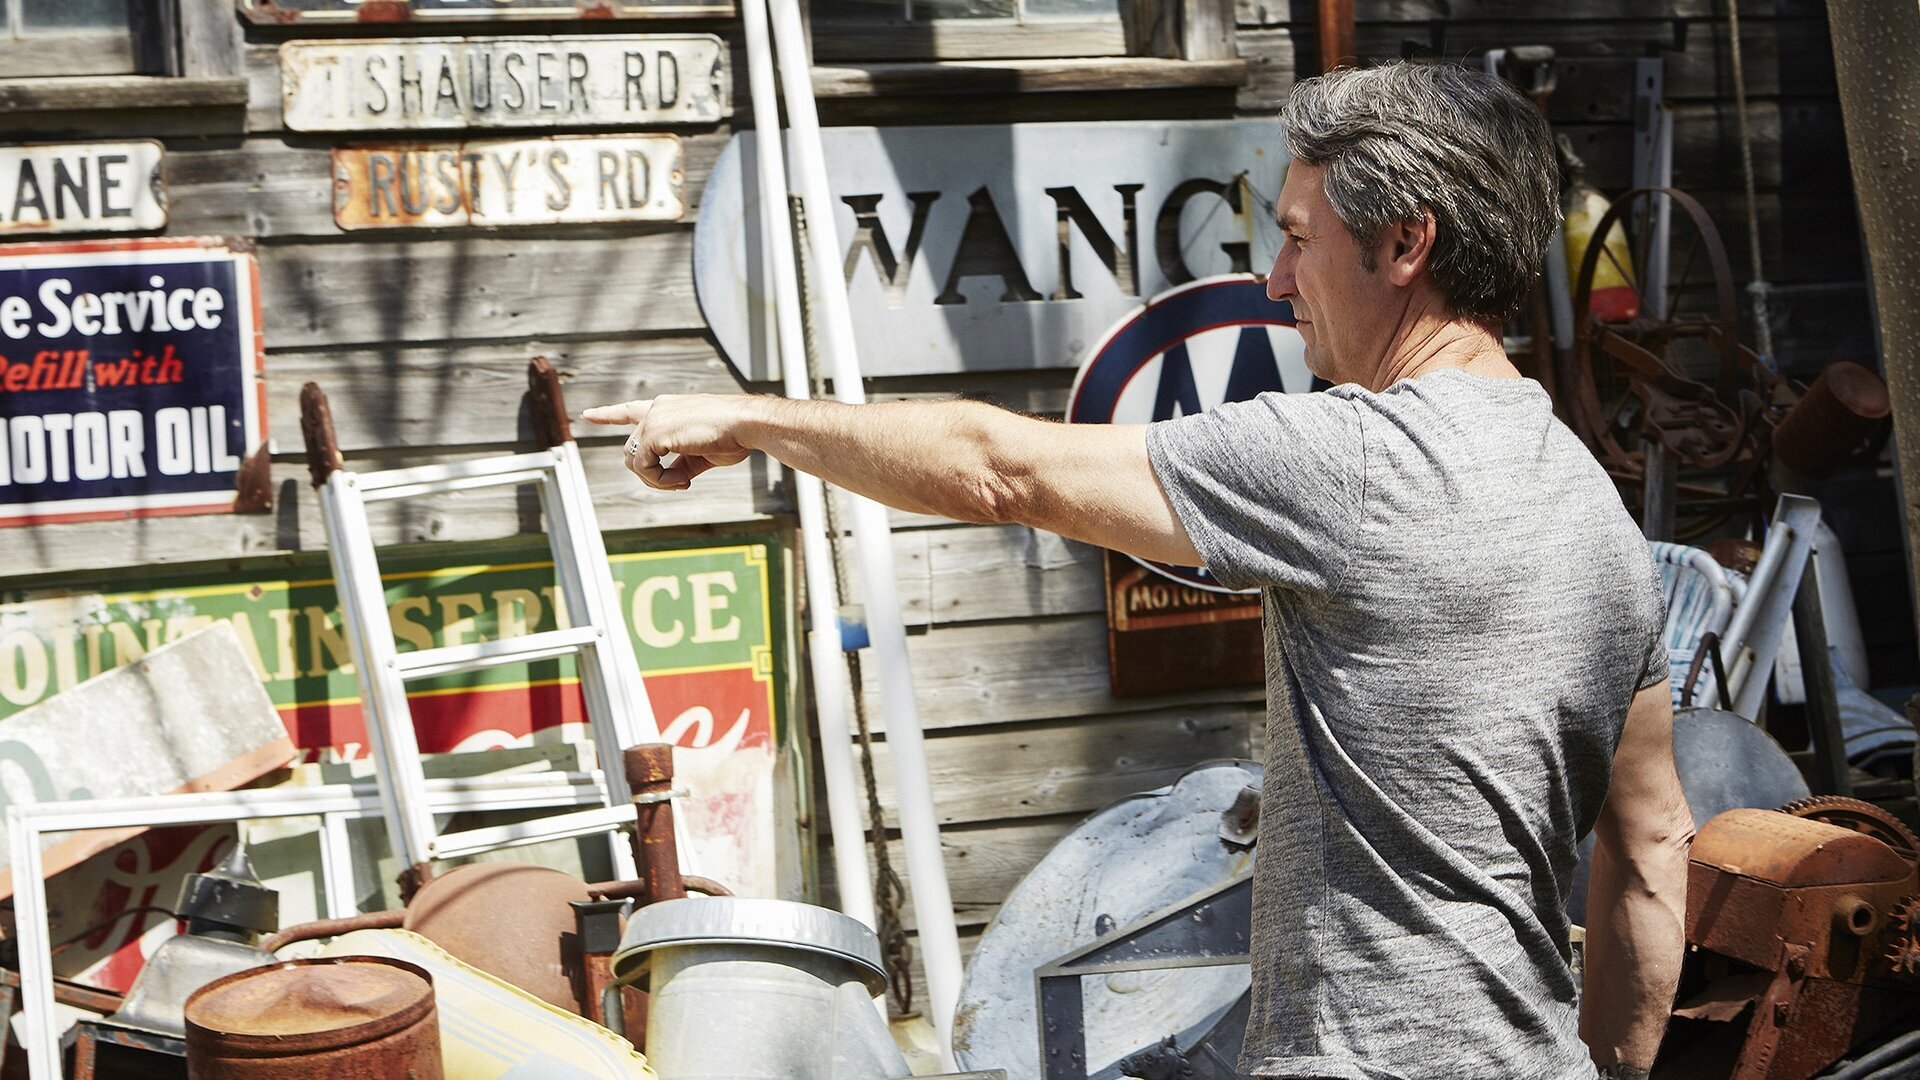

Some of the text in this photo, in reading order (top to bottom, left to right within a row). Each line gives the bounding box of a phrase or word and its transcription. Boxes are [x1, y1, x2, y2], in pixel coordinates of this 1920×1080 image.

[623, 50, 693, 111] RD.
[0, 155, 132, 222] ANE
[367, 149, 666, 218] RUSTY'S RD.
[37, 275, 224, 338] Service
[94, 345, 183, 387] with
[0, 405, 240, 486] OTOR OIL
[389, 571, 742, 654] SERCE
